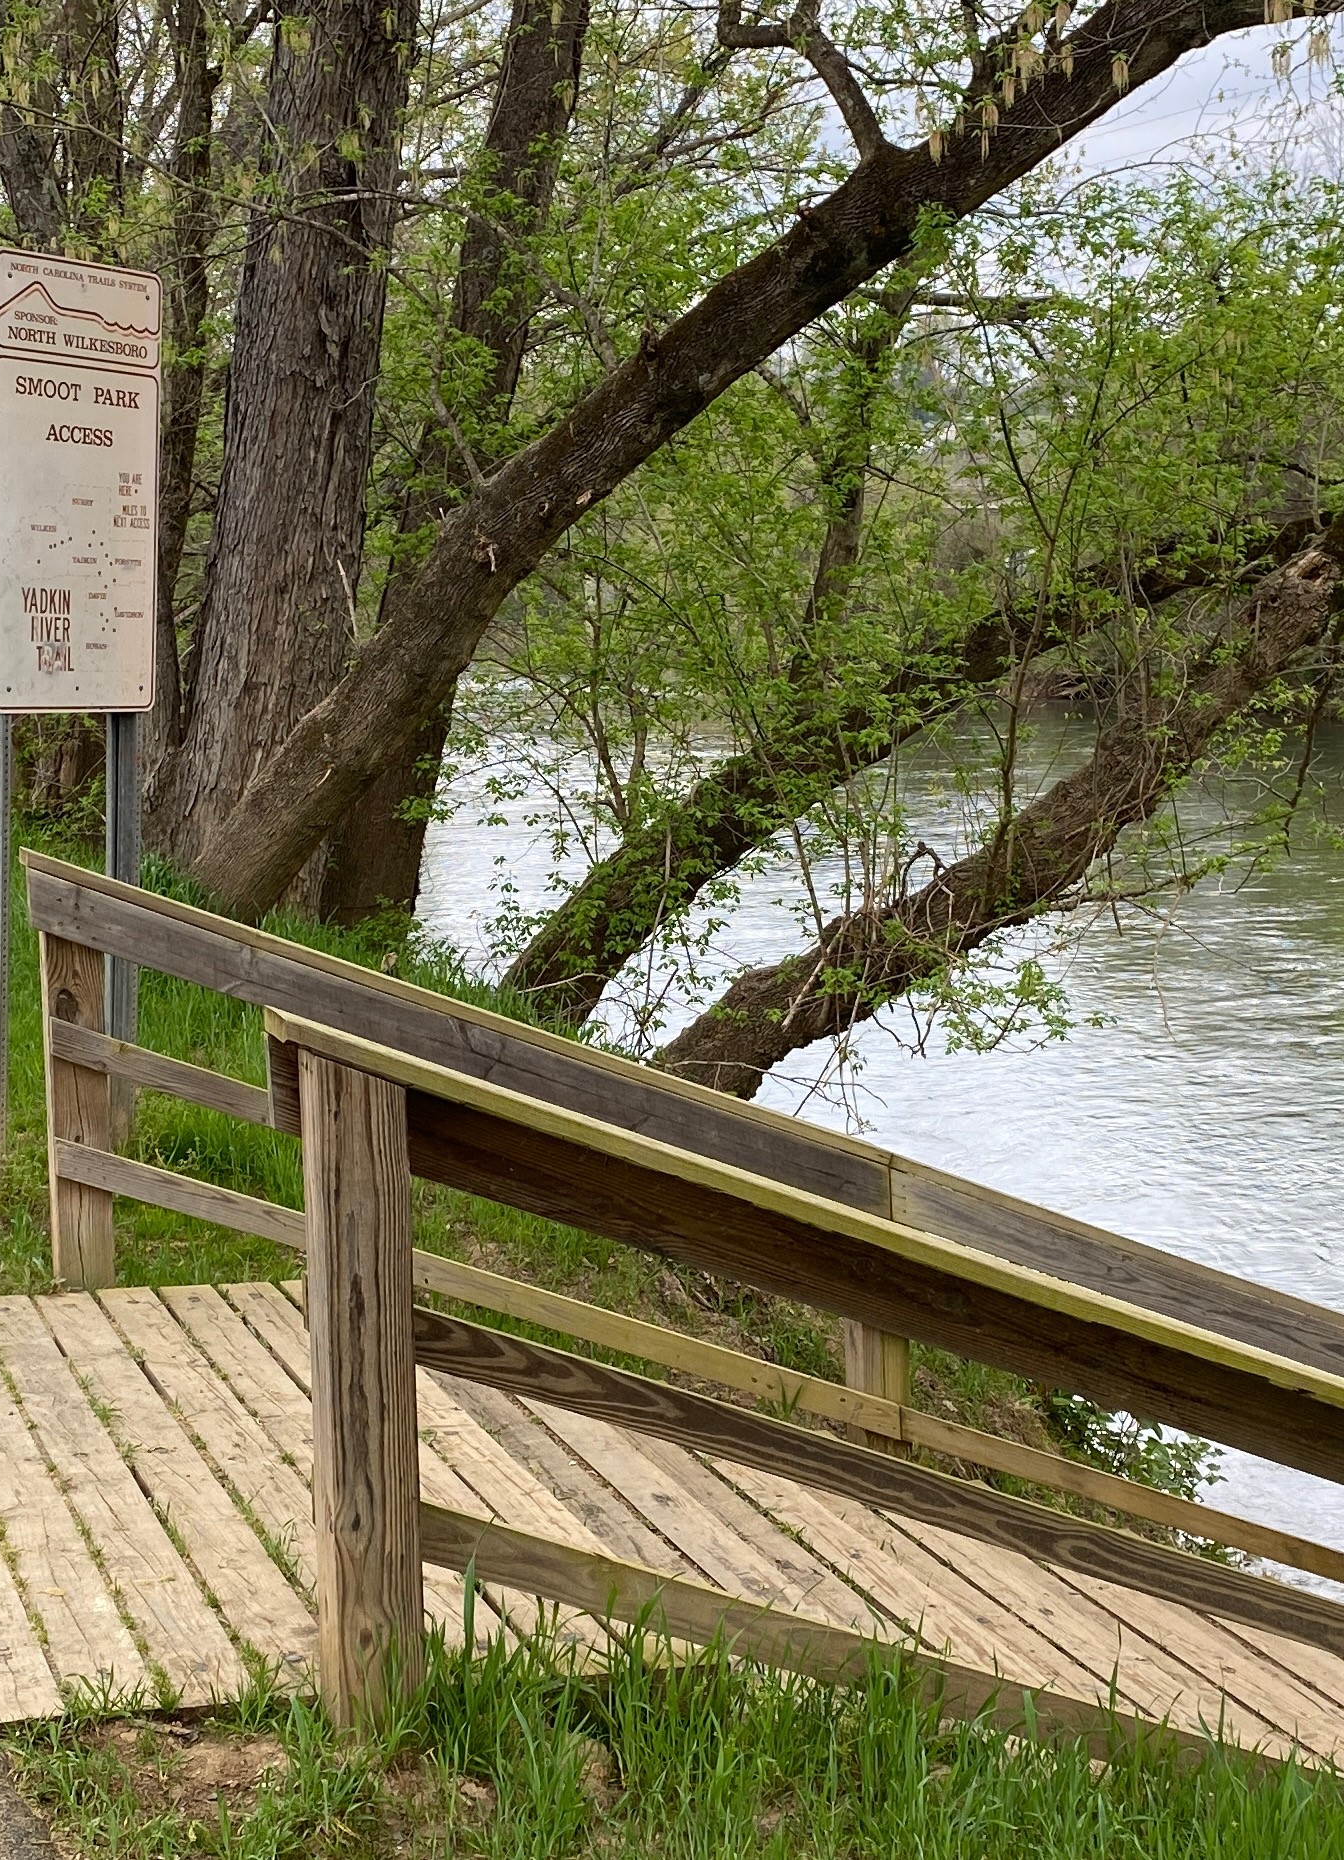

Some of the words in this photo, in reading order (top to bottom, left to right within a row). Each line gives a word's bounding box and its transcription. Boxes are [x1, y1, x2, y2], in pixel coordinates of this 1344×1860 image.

[10, 262, 38, 274] NORTH
[43, 268, 84, 282] CAROLINA
[88, 275, 116, 287] TRAILS
[119, 280, 147, 293] SYSTEM
[8, 326, 56, 345] NORTH
[63, 334, 148, 359] WILKESBORO
[16, 376, 81, 401] SMOOT
[93, 387, 140, 409] PARK
[46, 424, 113, 447] ACCESS
[118, 485, 132, 496] HERE
[119, 472, 129, 484] YOU
[132, 473, 142, 485] ARE
[130, 517, 150, 529] ACCESS
[21, 587, 71, 615] YADKIN
[31, 616, 70, 642] RIVER
